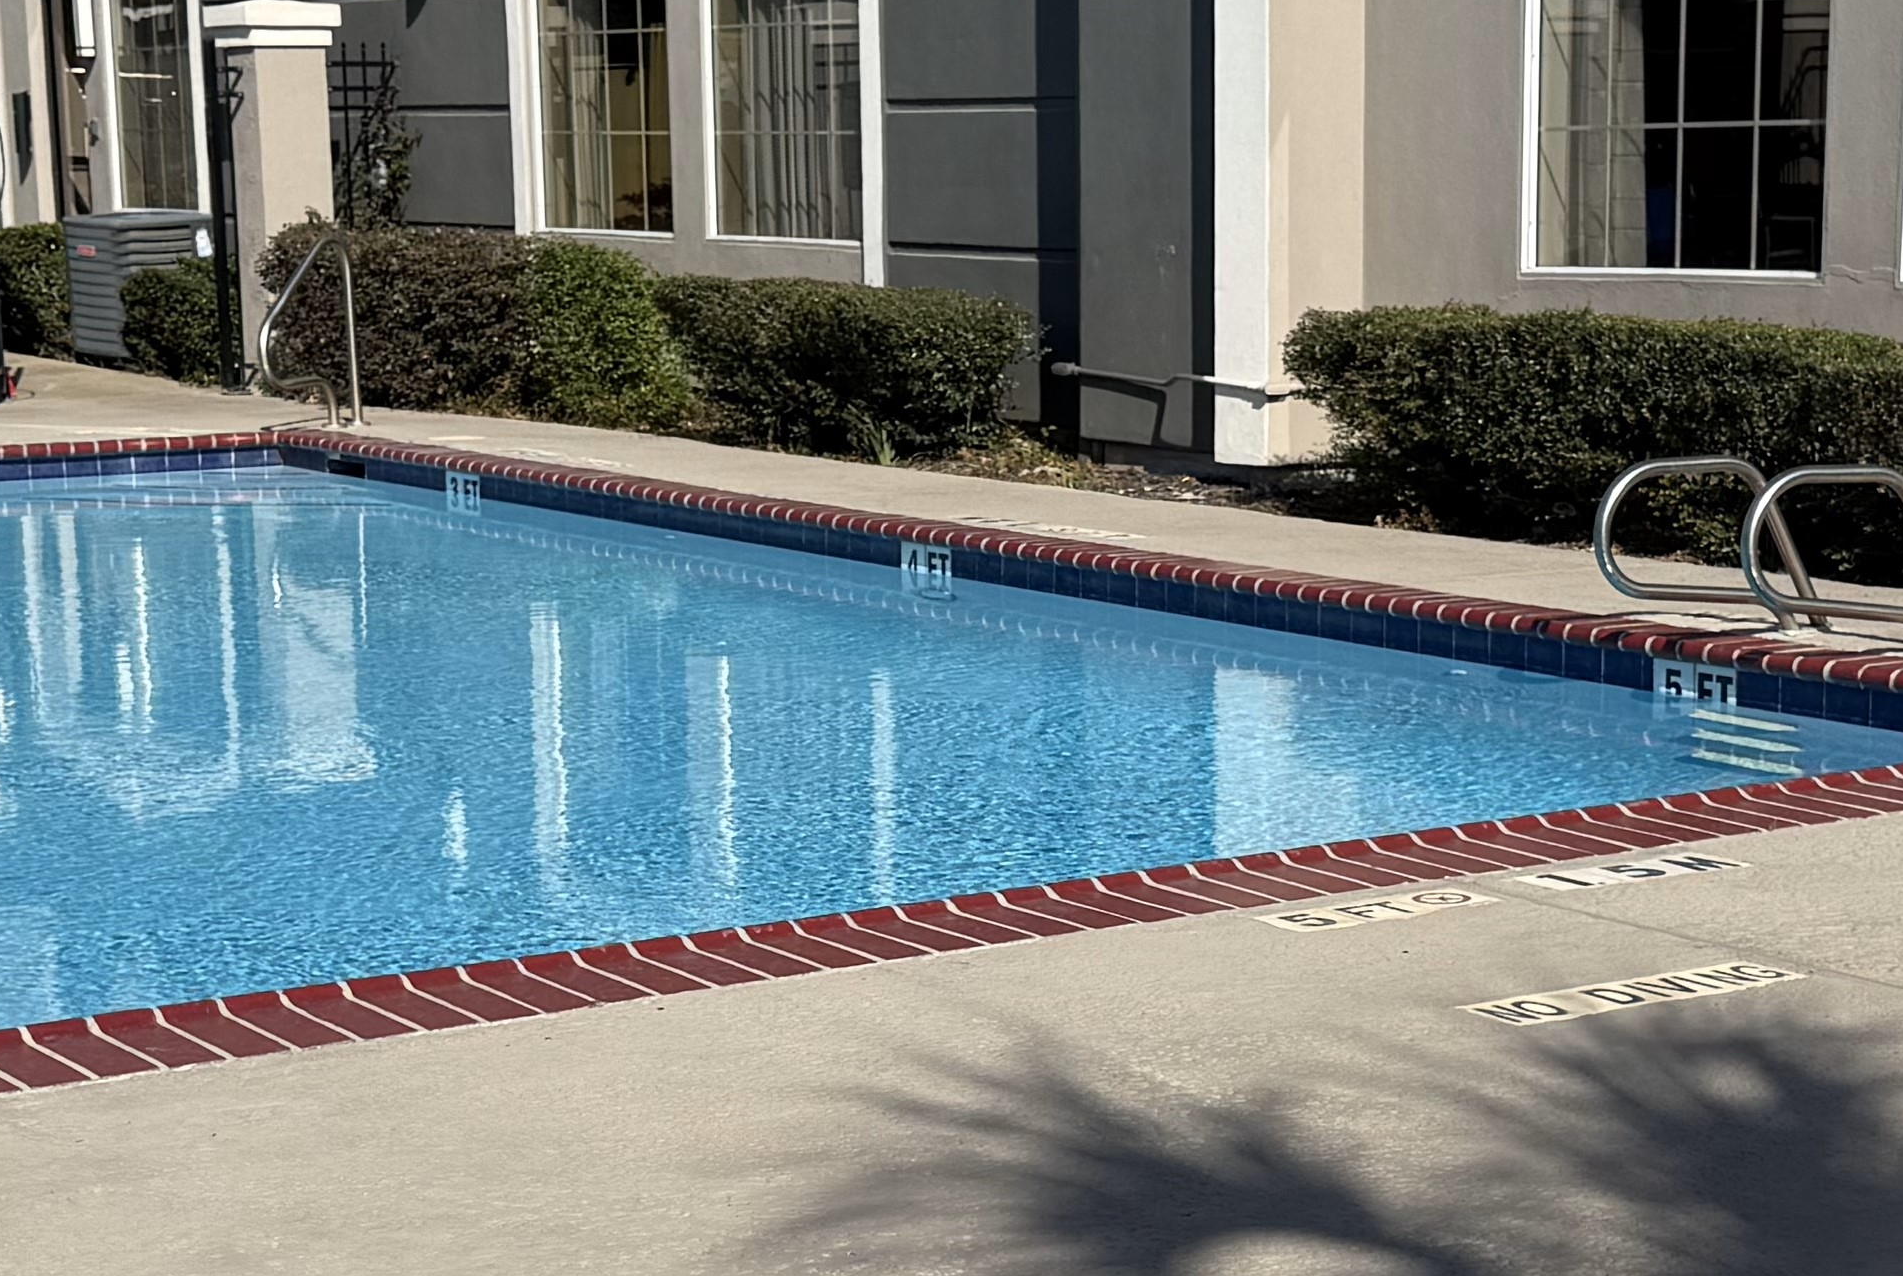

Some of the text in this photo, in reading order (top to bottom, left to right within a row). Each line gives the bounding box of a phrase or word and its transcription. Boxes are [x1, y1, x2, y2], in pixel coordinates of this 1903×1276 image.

[927, 551, 949, 575] FT
[1665, 668, 1734, 704] 5 FT
[1535, 856, 1741, 887] 1.5 M
[1277, 901, 1414, 927] 5 FT
[1473, 965, 1783, 1023] NO DIVING
